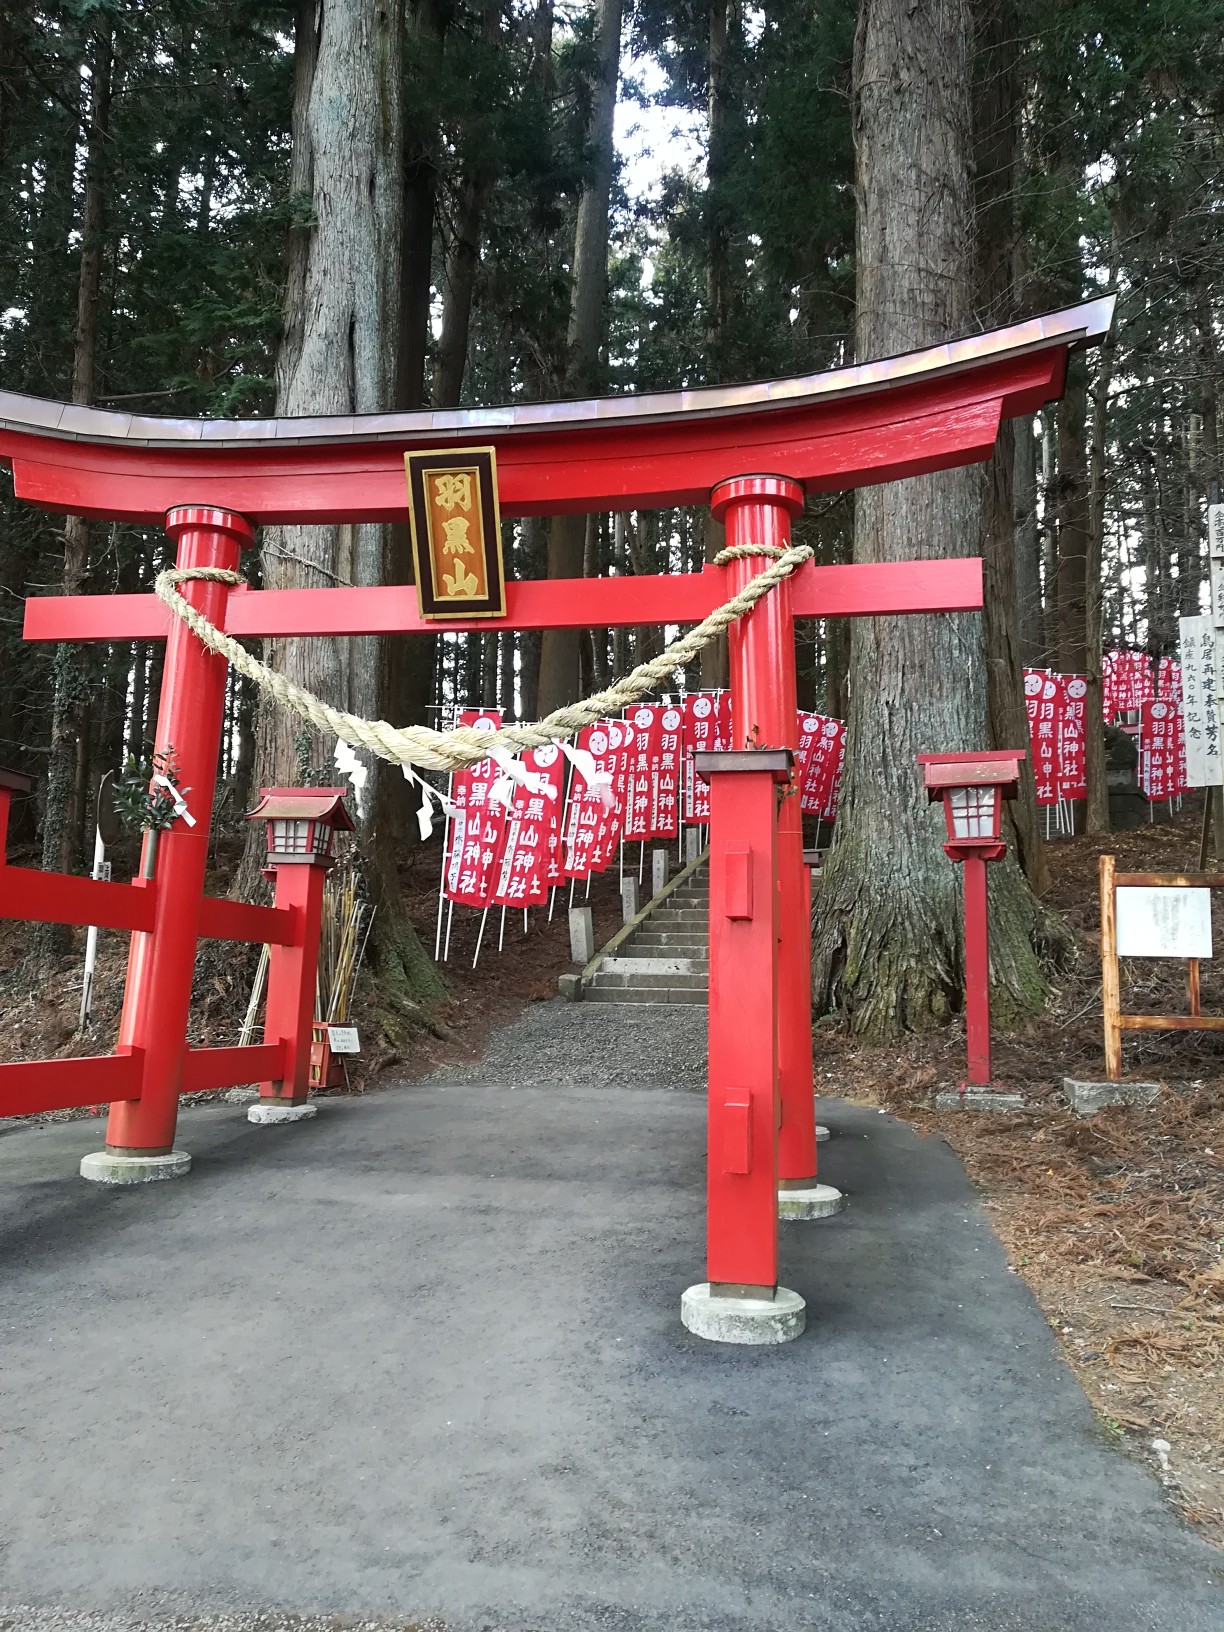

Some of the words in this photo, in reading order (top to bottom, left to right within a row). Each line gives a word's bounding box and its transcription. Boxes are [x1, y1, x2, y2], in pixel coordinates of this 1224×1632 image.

[434, 472, 479, 596] 羽黒山
[455, 785, 466, 807] 奉納
[632, 732, 650, 834] 羽黒山神社
[657, 733, 678, 831] 羽黒山神社
[694, 721, 711, 817] 羽黒神社
[1151, 721, 1165, 796] 羽黒山神社
